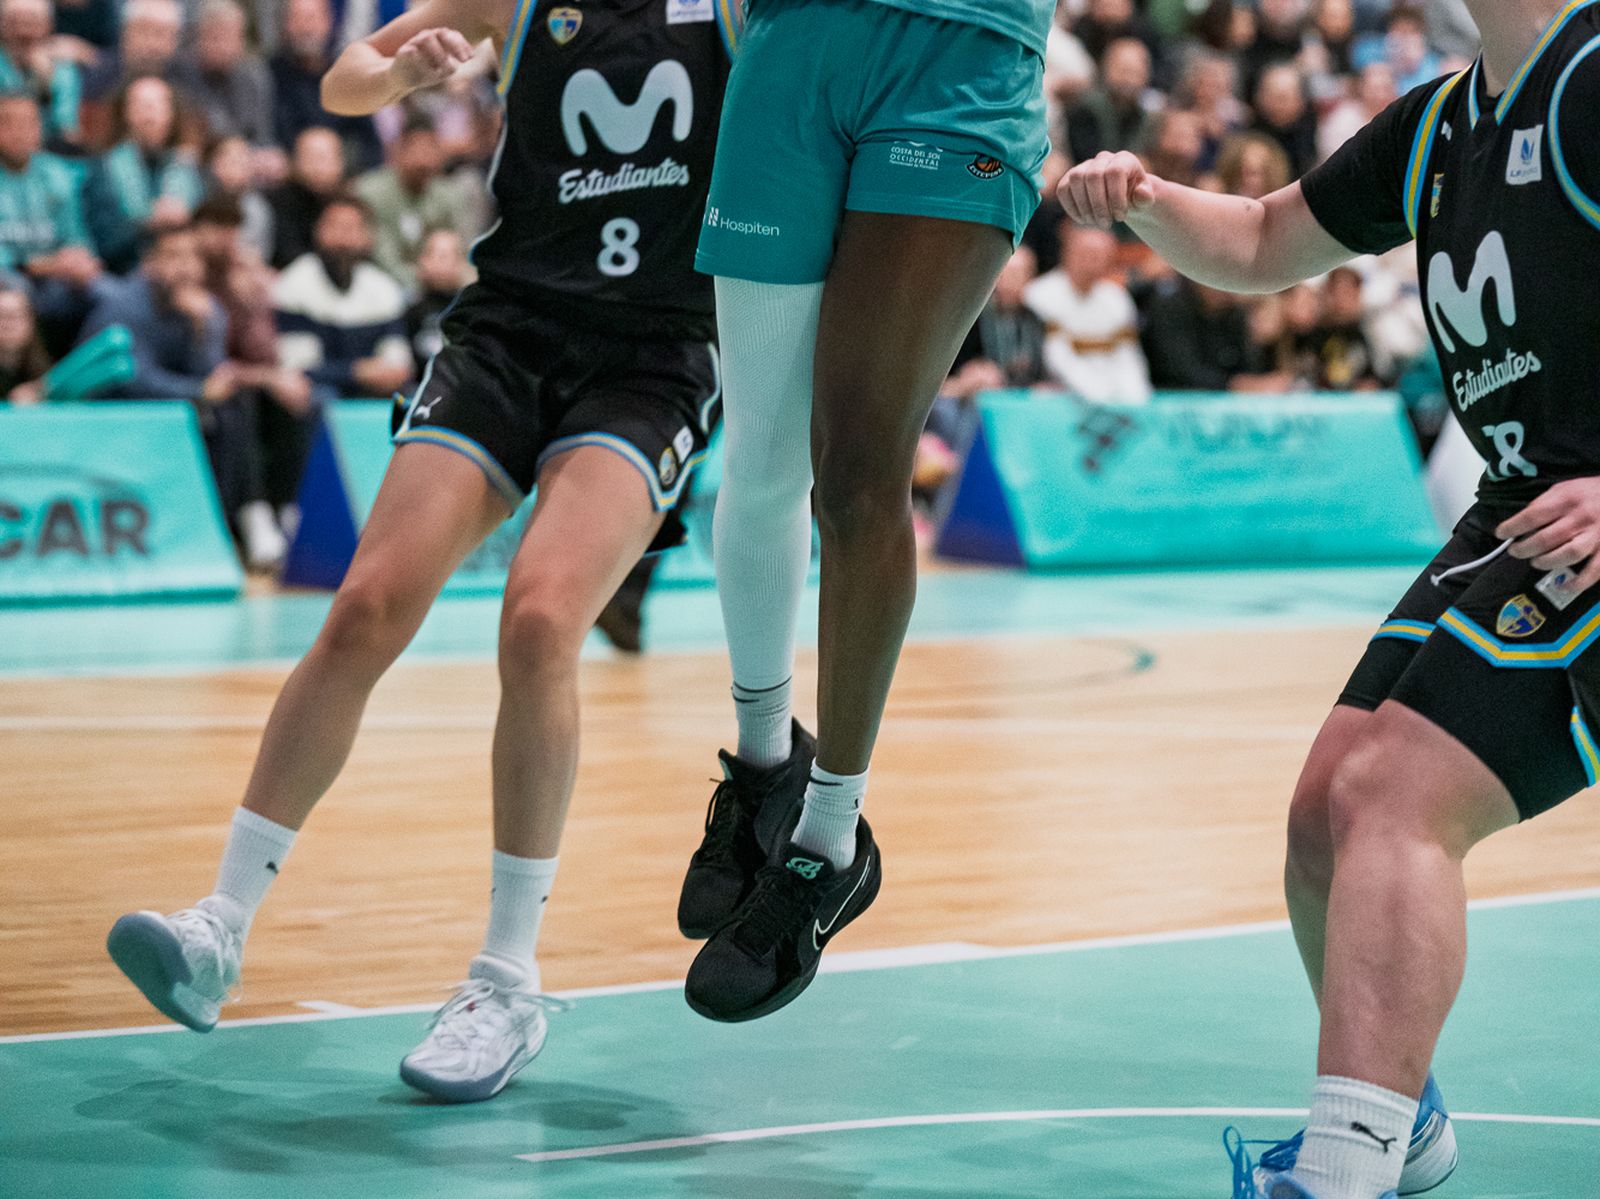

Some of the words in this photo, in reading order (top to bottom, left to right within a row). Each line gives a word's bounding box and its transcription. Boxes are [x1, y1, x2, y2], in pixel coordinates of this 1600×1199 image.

[889, 153, 939, 167] OCCIDENTAL
[890, 146, 913, 156] COSTA
[558, 156, 691, 204] Estudiantes
[720, 217, 780, 236] Hospiten
[597, 216, 640, 278] 8
[1452, 347, 1542, 413] Estudiates
